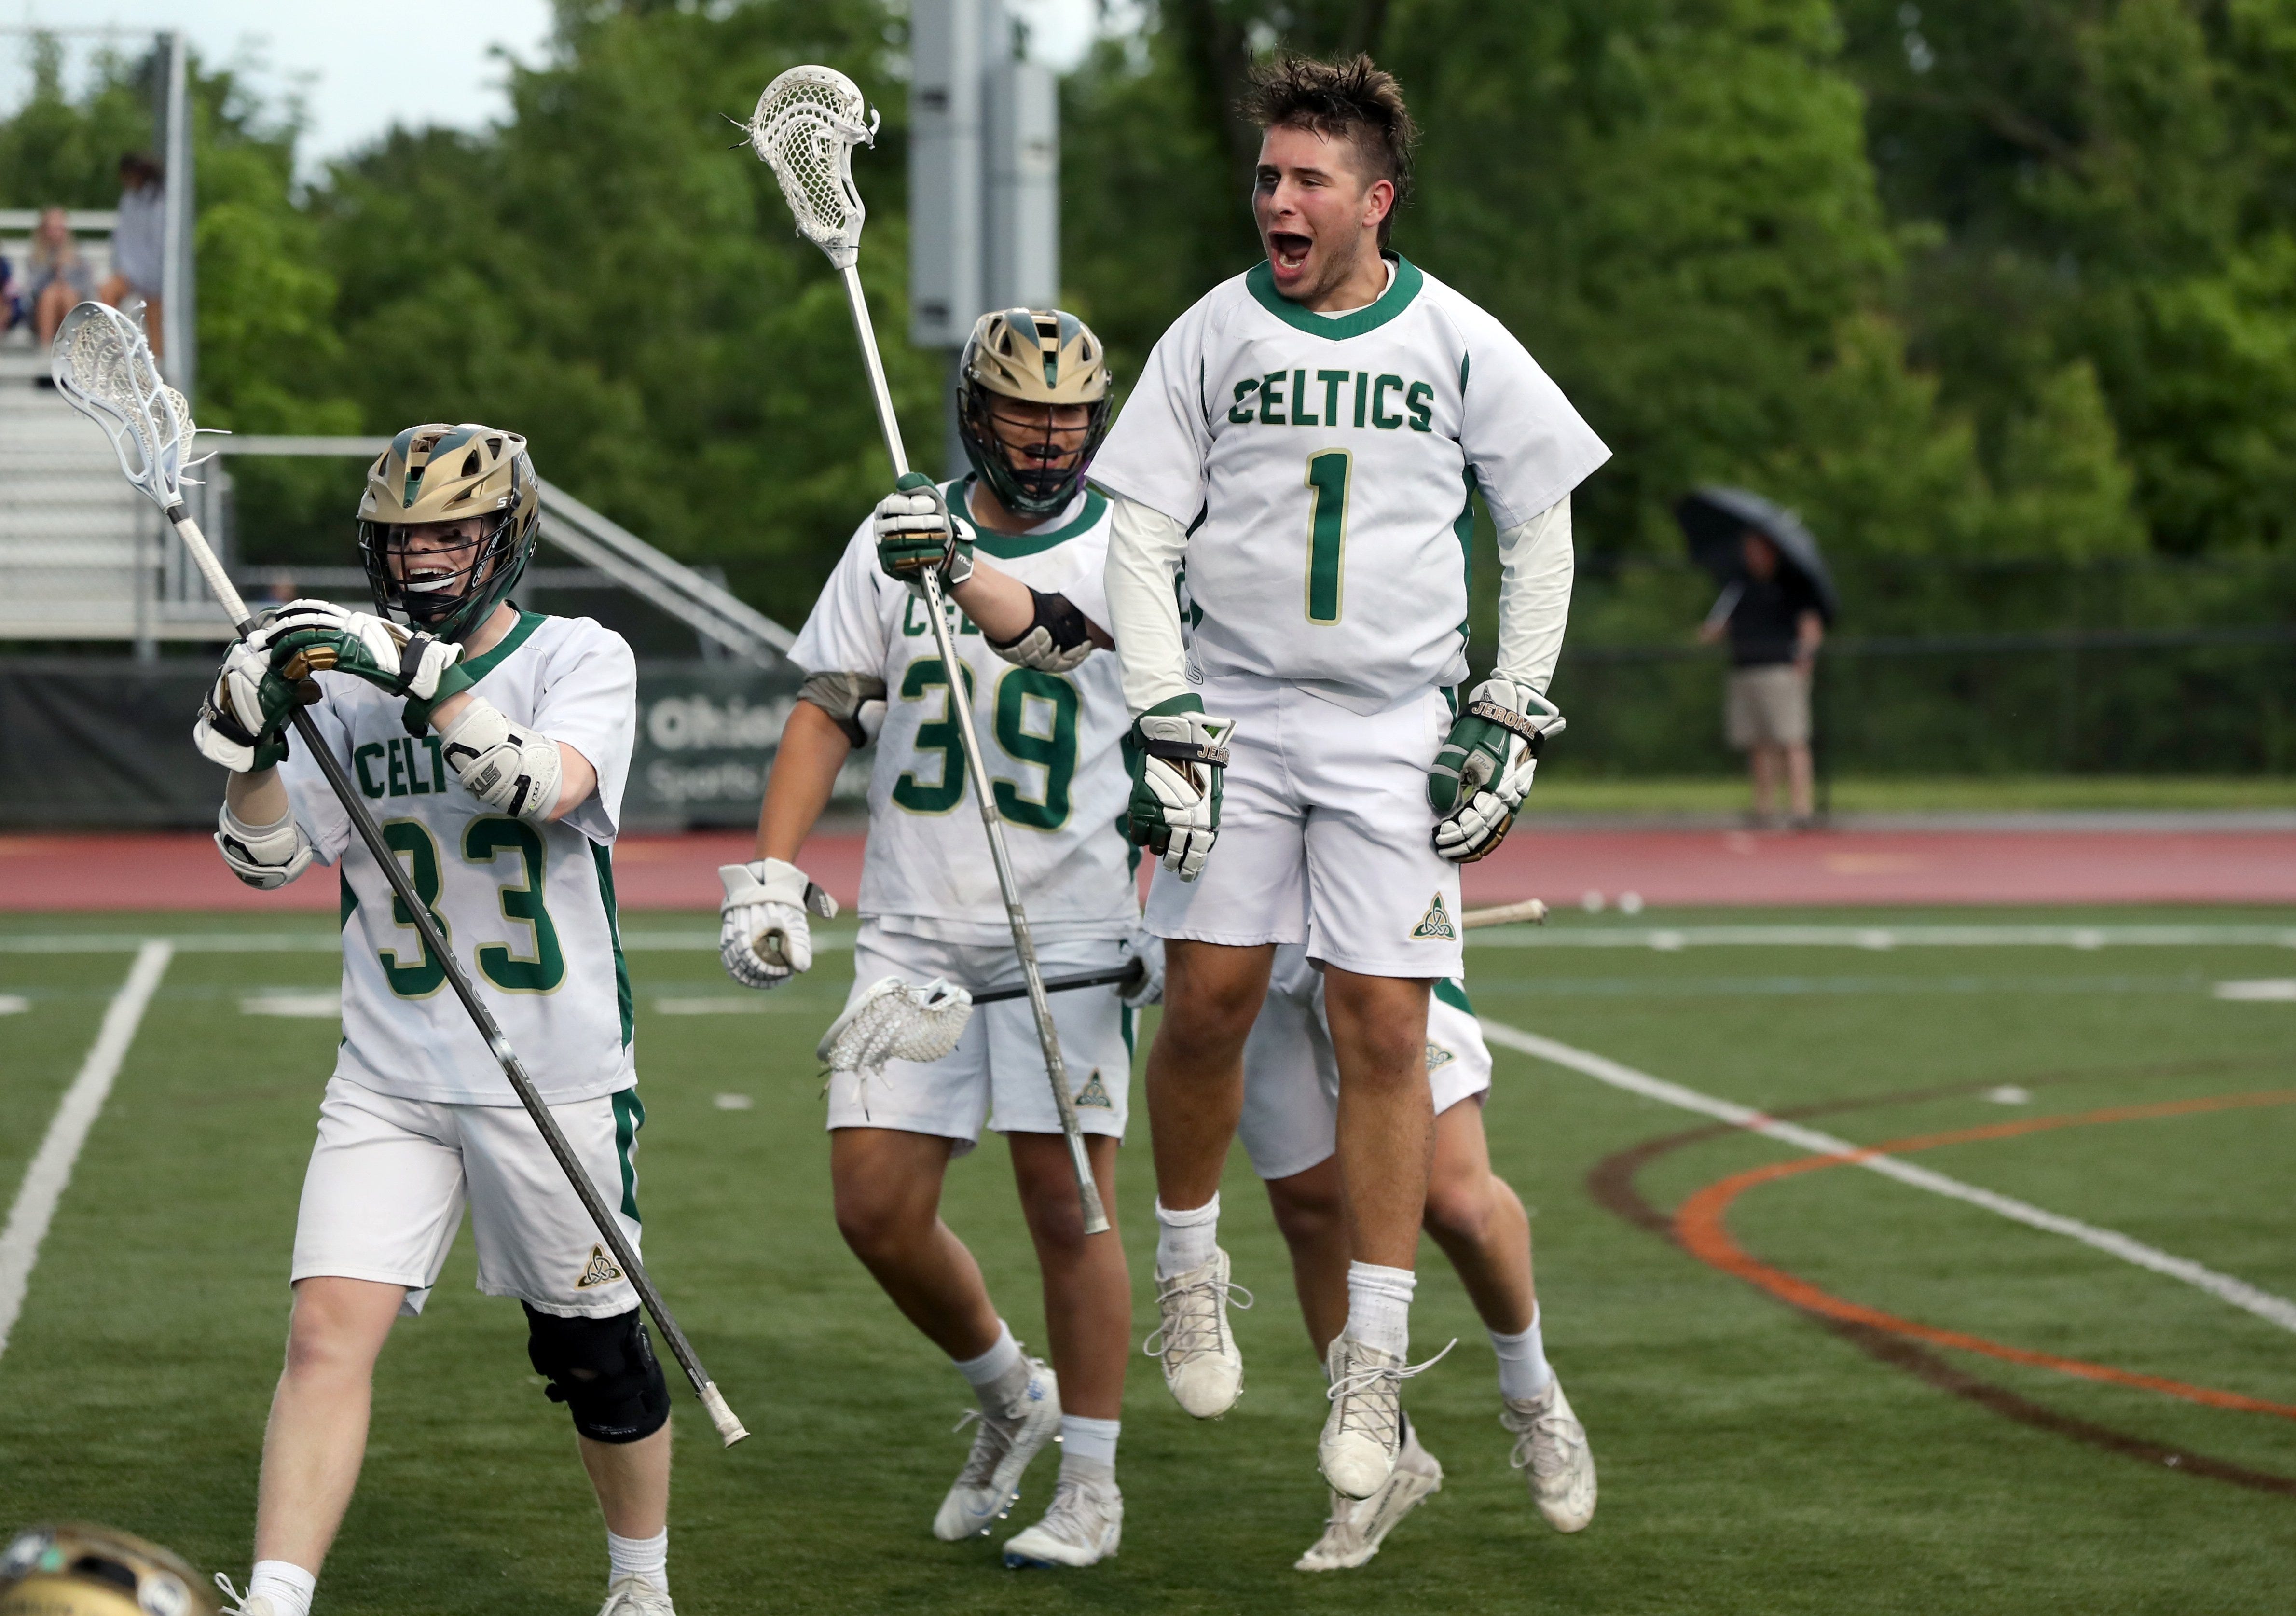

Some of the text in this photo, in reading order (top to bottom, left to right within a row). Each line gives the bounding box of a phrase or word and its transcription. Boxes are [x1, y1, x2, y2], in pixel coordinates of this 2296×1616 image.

[1228, 368, 1434, 432] CELTICS
[1304, 447, 1353, 627] 1
[890, 655, 1082, 833] 39
[1471, 701, 1538, 741] JEROME
[378, 813, 568, 1000] 33
